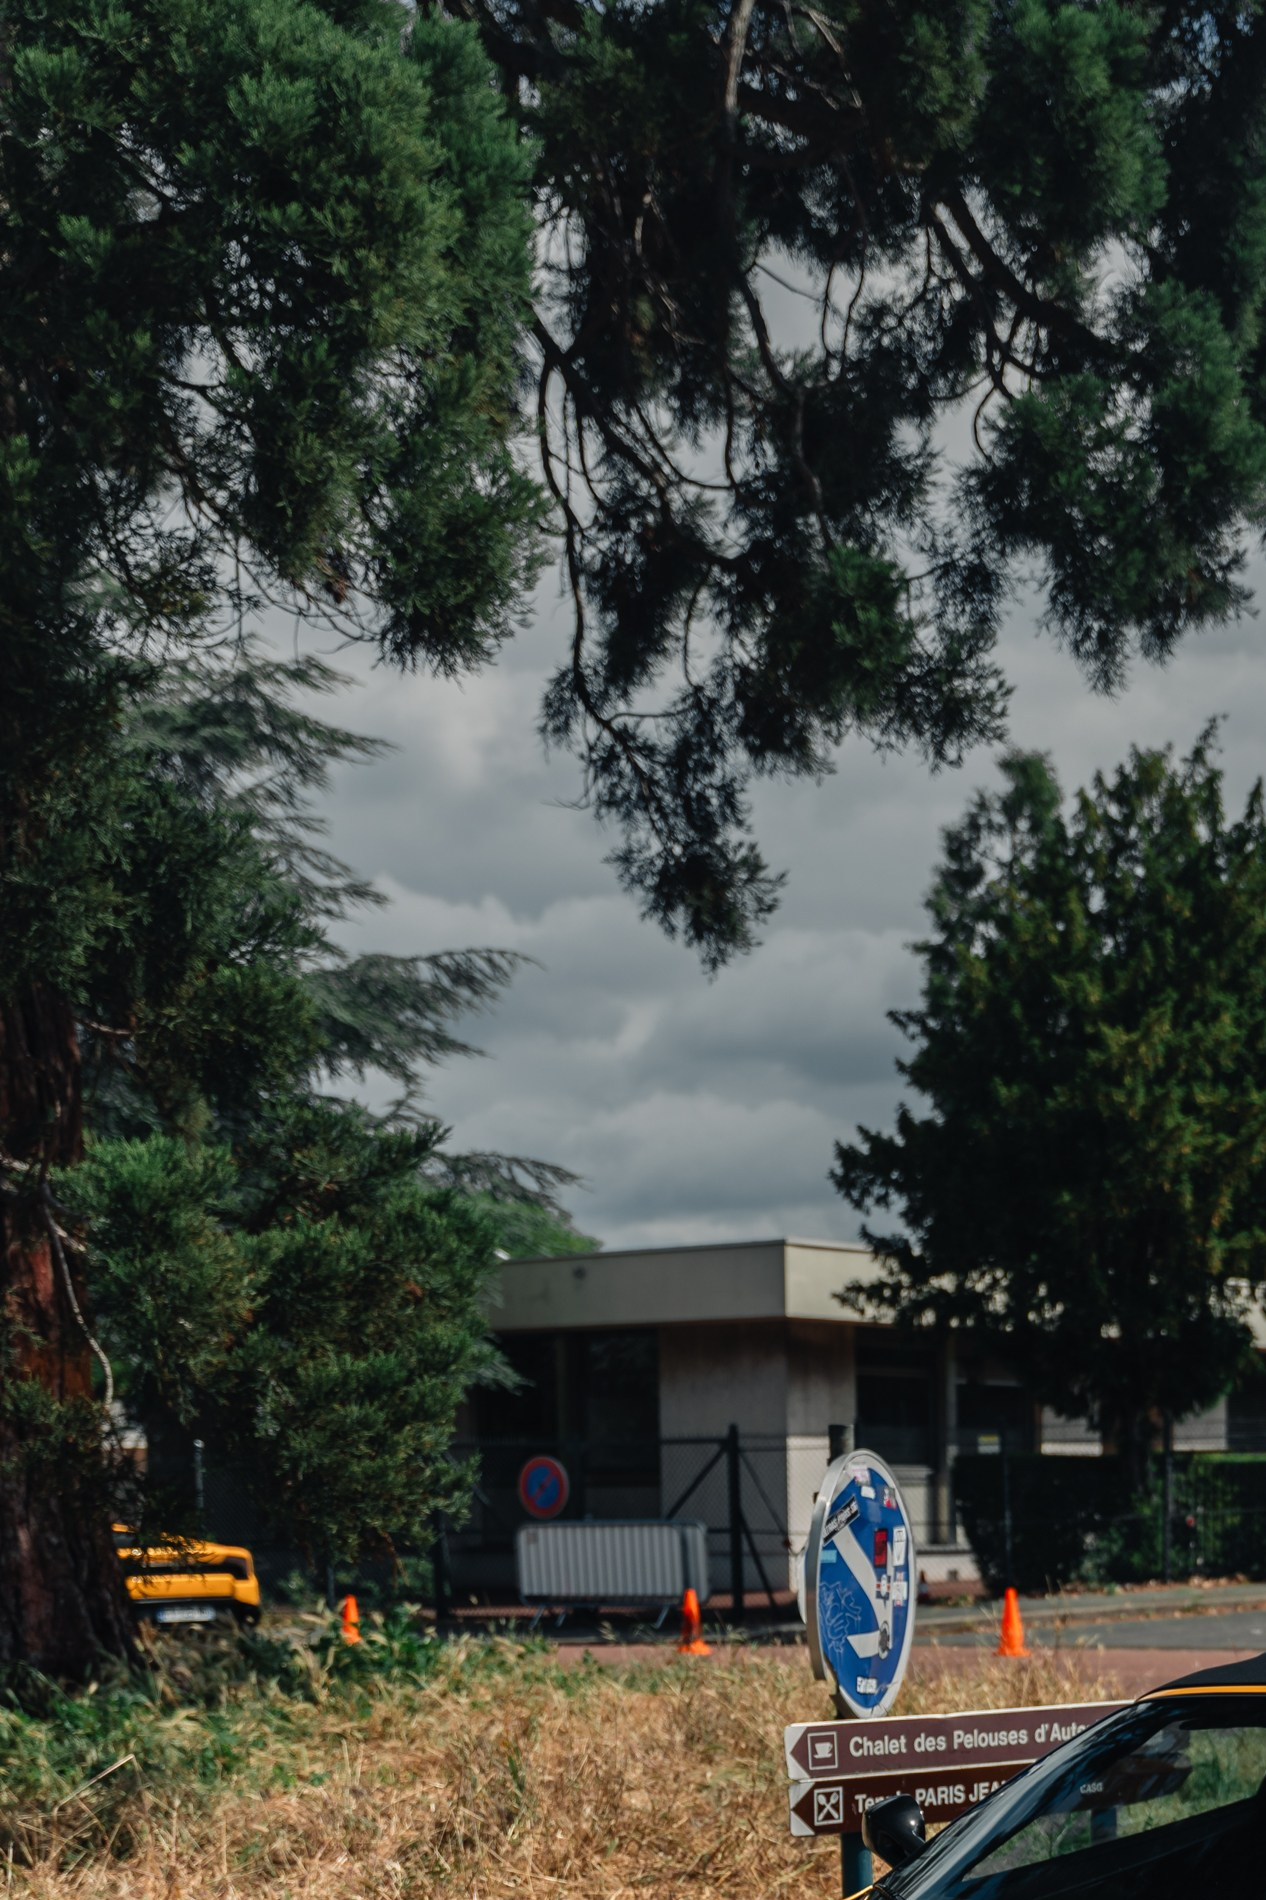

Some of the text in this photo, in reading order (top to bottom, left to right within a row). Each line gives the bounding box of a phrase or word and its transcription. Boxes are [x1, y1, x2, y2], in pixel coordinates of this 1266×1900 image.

[849, 1735, 907, 1757] Chalet
[913, 1733, 946, 1753] des
[953, 1728, 1028, 1750] Pelouses
[914, 1784, 966, 1807] PARIS
[968, 1780, 1007, 1803] JEA
